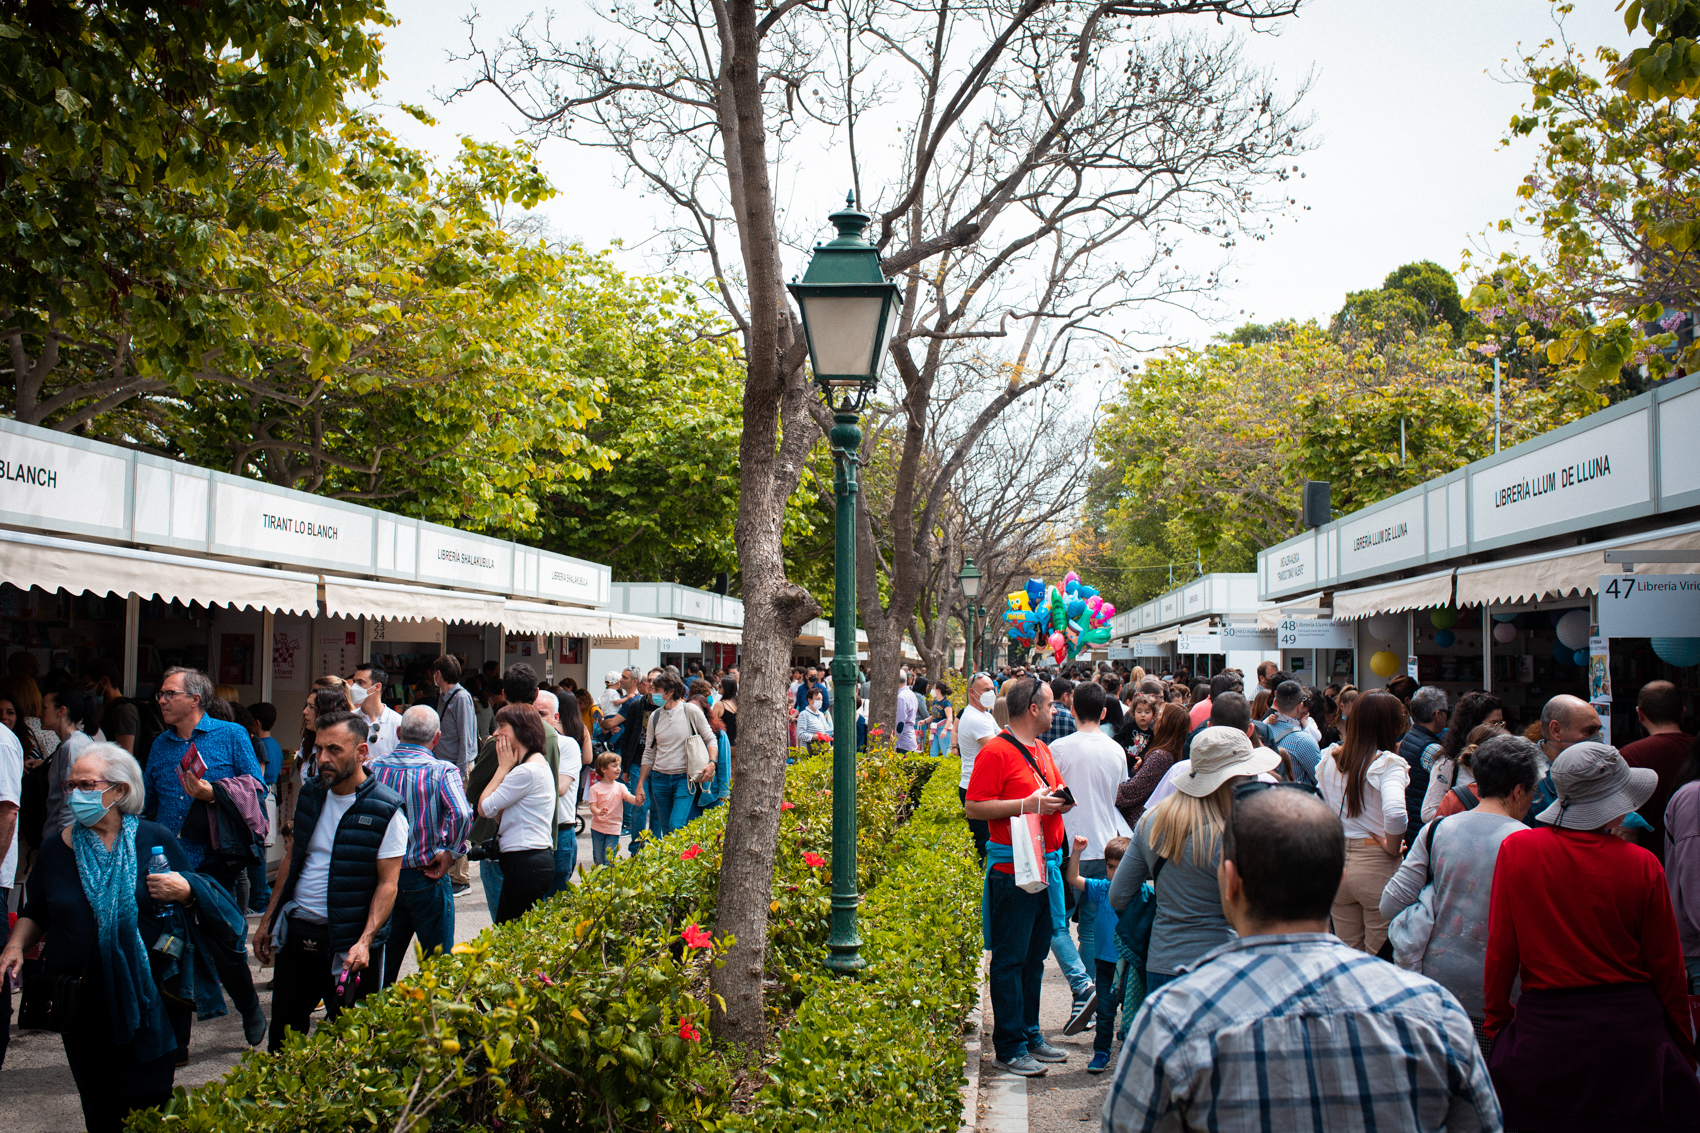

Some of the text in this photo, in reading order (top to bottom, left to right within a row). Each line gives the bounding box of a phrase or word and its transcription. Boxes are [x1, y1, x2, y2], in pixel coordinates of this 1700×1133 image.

[0, 460, 57, 488] BLANCH
[1494, 454, 1611, 508] LIBRERÍA LLUM DE LLUNA
[262, 513, 338, 540] TIRANT LO BLANCH
[1353, 521, 1408, 551] LIBRERÍA LLUM DE LLUNA
[461, 553, 495, 569] SHALAKUBULA
[1605, 578, 1636, 599] 47
[1637, 581, 1677, 591] Librería
[374, 622, 385, 631] 23
[1223, 628, 1235, 636] 50
[1281, 620, 1296, 631] 48
[373, 631, 385, 640] 24
[593, 638, 602, 646] 21
[1281, 634, 1296, 645] 49
